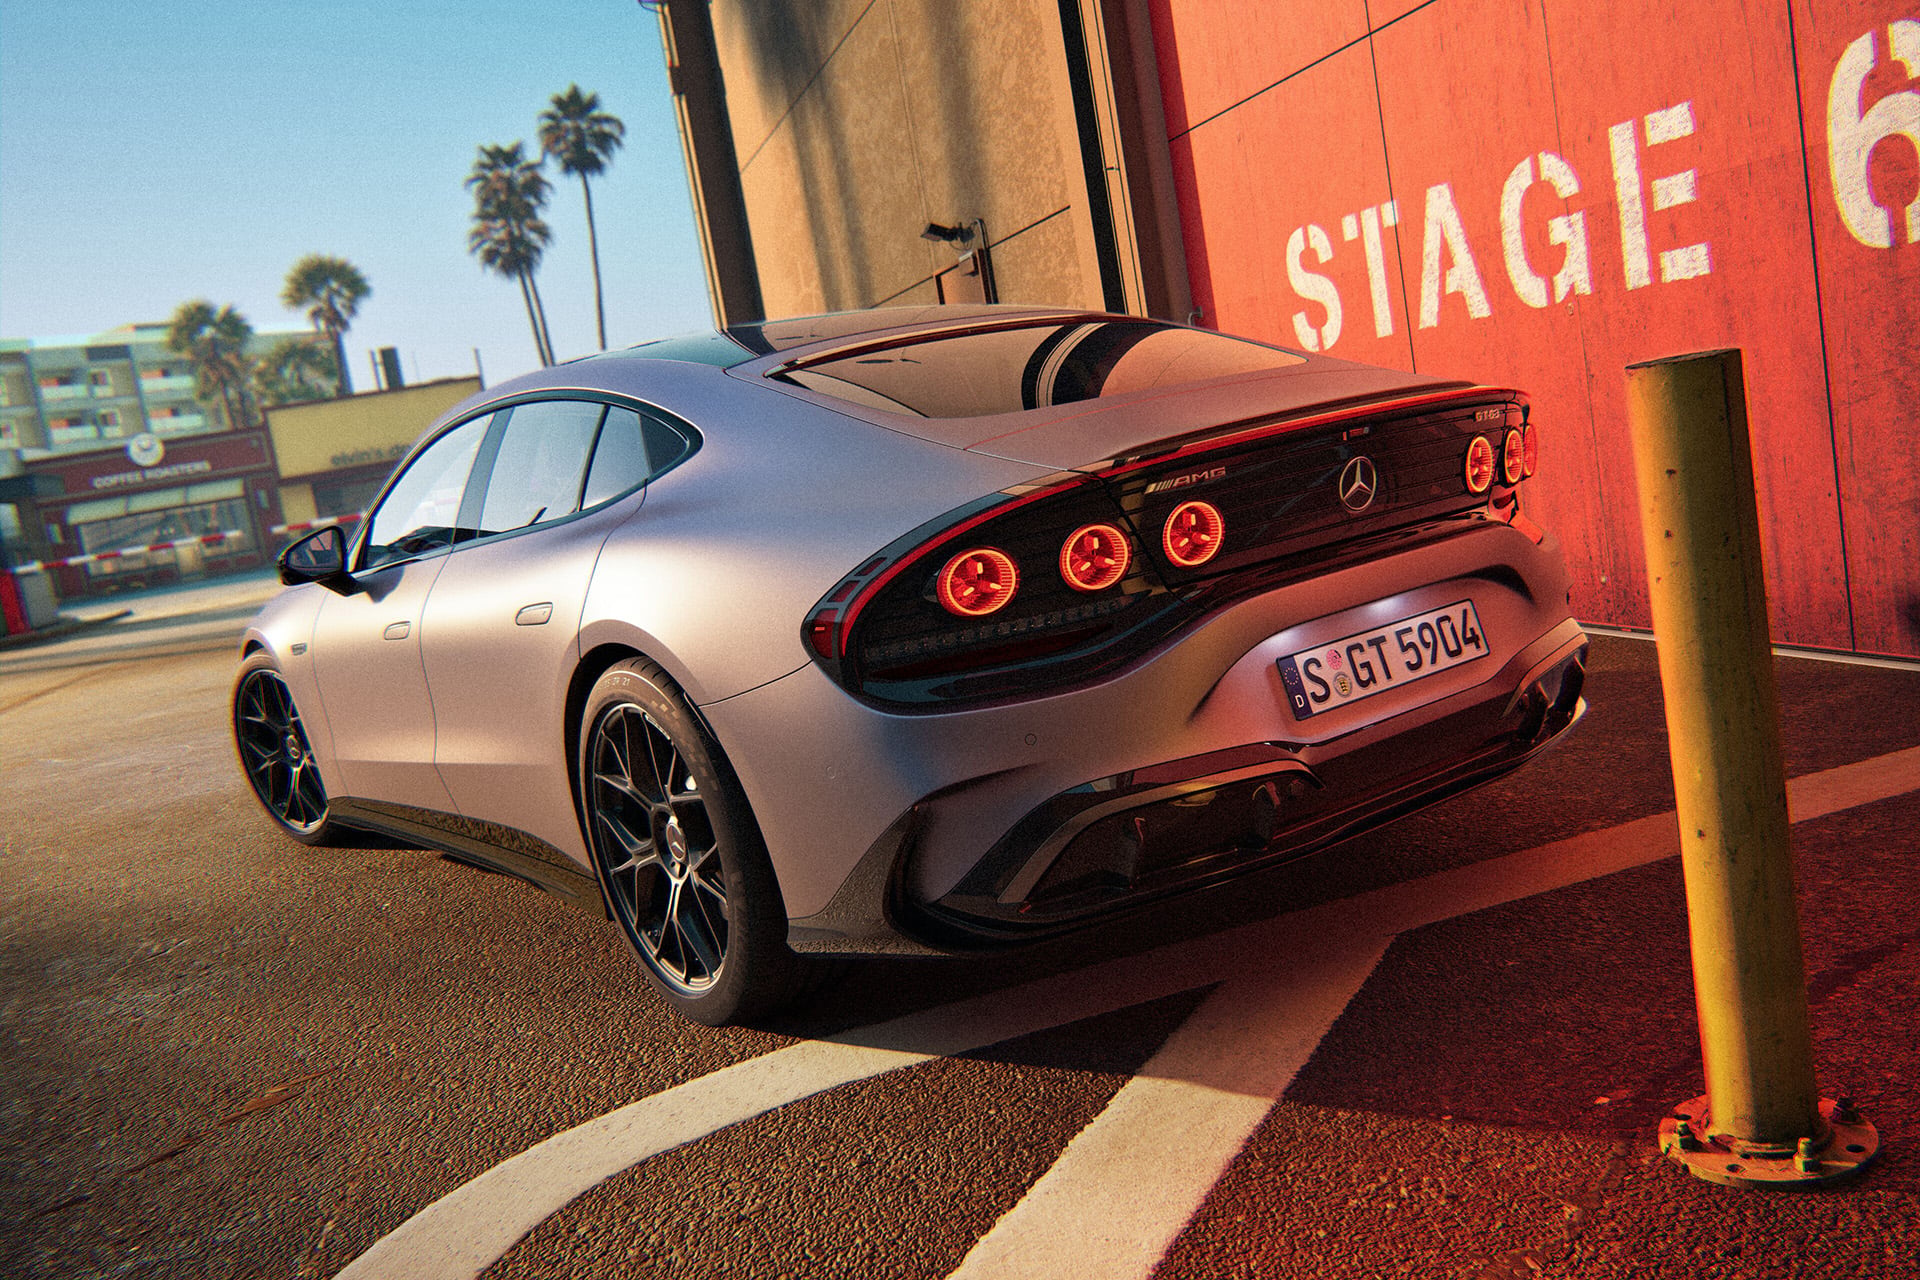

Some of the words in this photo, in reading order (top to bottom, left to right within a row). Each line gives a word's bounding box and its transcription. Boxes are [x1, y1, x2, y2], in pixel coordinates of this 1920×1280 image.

[1285, 101, 1713, 352] STAGE
[1827, 18, 1920, 249] 6
[93, 470, 143, 489] COFFEE
[145, 460, 212, 479] ROASTERS
[1172, 467, 1226, 487] AMG
[1303, 657, 1330, 703] S
[1346, 635, 1392, 688] GT
[1395, 608, 1481, 671] 5904
[1295, 694, 1305, 708] D
